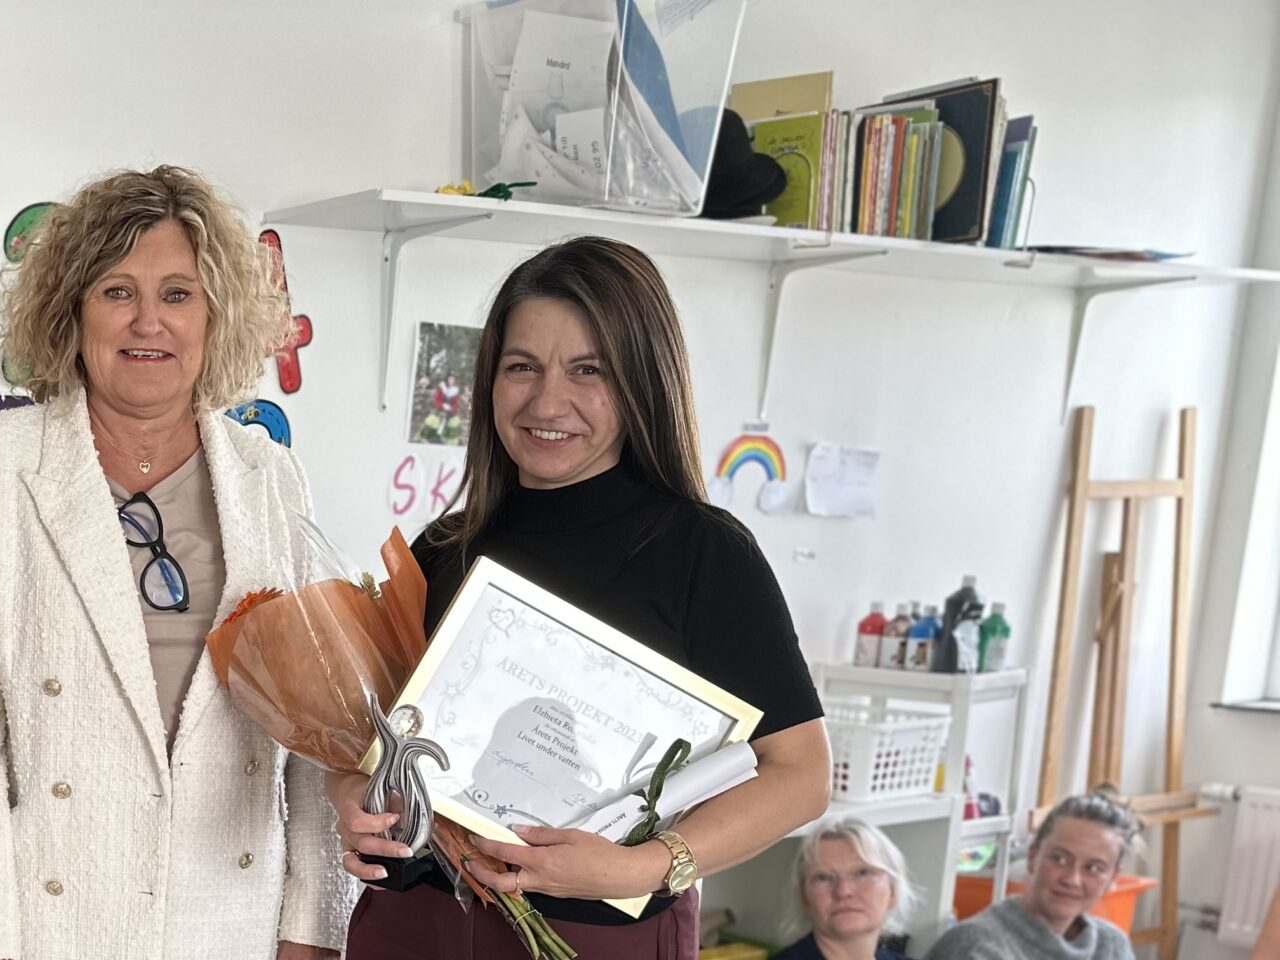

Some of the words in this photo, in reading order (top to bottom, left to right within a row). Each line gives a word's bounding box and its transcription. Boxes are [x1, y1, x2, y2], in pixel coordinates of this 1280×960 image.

[497, 656, 547, 691] ÅRETS
[547, 684, 616, 728] PROJEKT
[613, 720, 643, 744] 2023
[516, 730, 536, 747] Livet
[535, 740, 559, 758] under
[558, 755, 581, 771] vatten
[531, 724, 552, 741] Årets
[552, 736, 578, 757] Projekt
